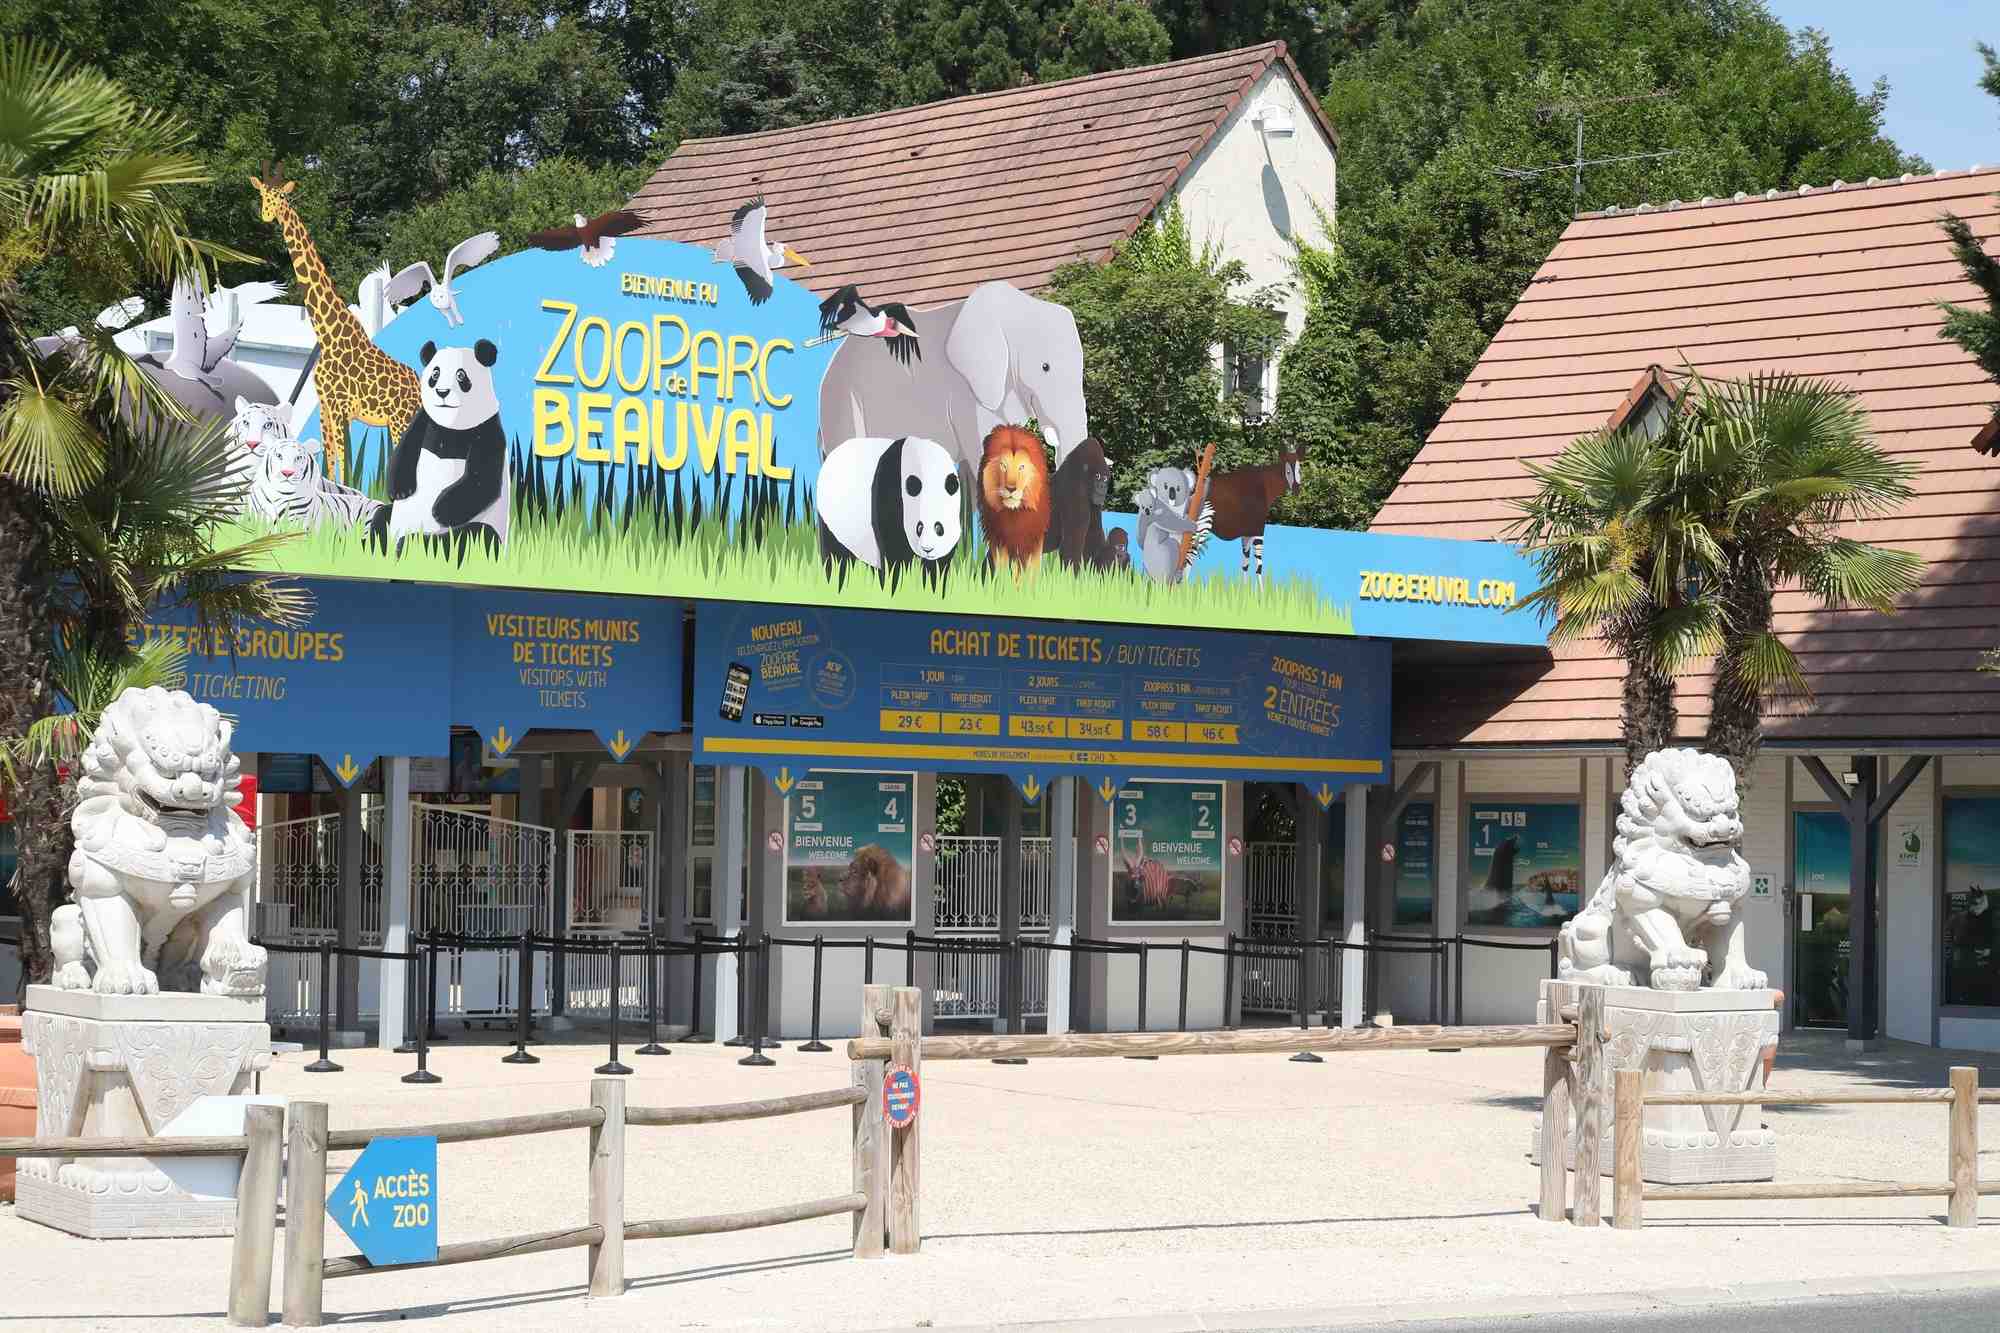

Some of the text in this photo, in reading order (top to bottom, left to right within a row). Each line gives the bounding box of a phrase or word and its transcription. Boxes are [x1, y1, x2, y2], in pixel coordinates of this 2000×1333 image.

[621, 272, 718, 304] BIENVENUE AU
[665, 371, 688, 395] de
[533, 387, 794, 480] BEAUVAL
[1360, 570, 1516, 607] ZOOBEAUVAL.COM
[487, 614, 640, 643] VISITEURS MUNIS
[751, 619, 802, 641] NOUVEAU
[236, 626, 345, 661] GROUPES
[513, 641, 614, 667] DE TICKETS
[930, 628, 992, 657] ACHAT
[997, 633, 1021, 658] DE
[1026, 633, 1102, 663] TICKETS
[1118, 644, 1145, 665] BUY
[1148, 646, 1202, 668] TICKETS
[519, 667, 608, 688] VISITORS WITH
[760, 663, 802, 680] BEAUVAL
[926, 671, 944, 683] JOUR
[1271, 655, 1319, 684] ZOOPASS
[1328, 672, 1345, 690] AN
[193, 673, 288, 701] TICKETING
[538, 688, 588, 708] TICKETS
[1263, 685, 1278, 709] 2
[898, 715, 923, 728] 29 €
[959, 718, 983, 730] 23 €
[1202, 728, 1216, 740] 46
[802, 795, 816, 818] 5
[884, 797, 897, 819] 4
[1125, 804, 1137, 826] 3
[1198, 805, 1209, 827] 2
[795, 835, 853, 847] BIENVENUE
[1482, 823, 1489, 845] 1
[808, 850, 848, 860] WELCOME
[1152, 842, 1202, 854] BIENVENUE
[1176, 855, 1211, 865] WELCOME
[373, 1168, 429, 1199] ACCÈS
[393, 1203, 429, 1228] ZOO
